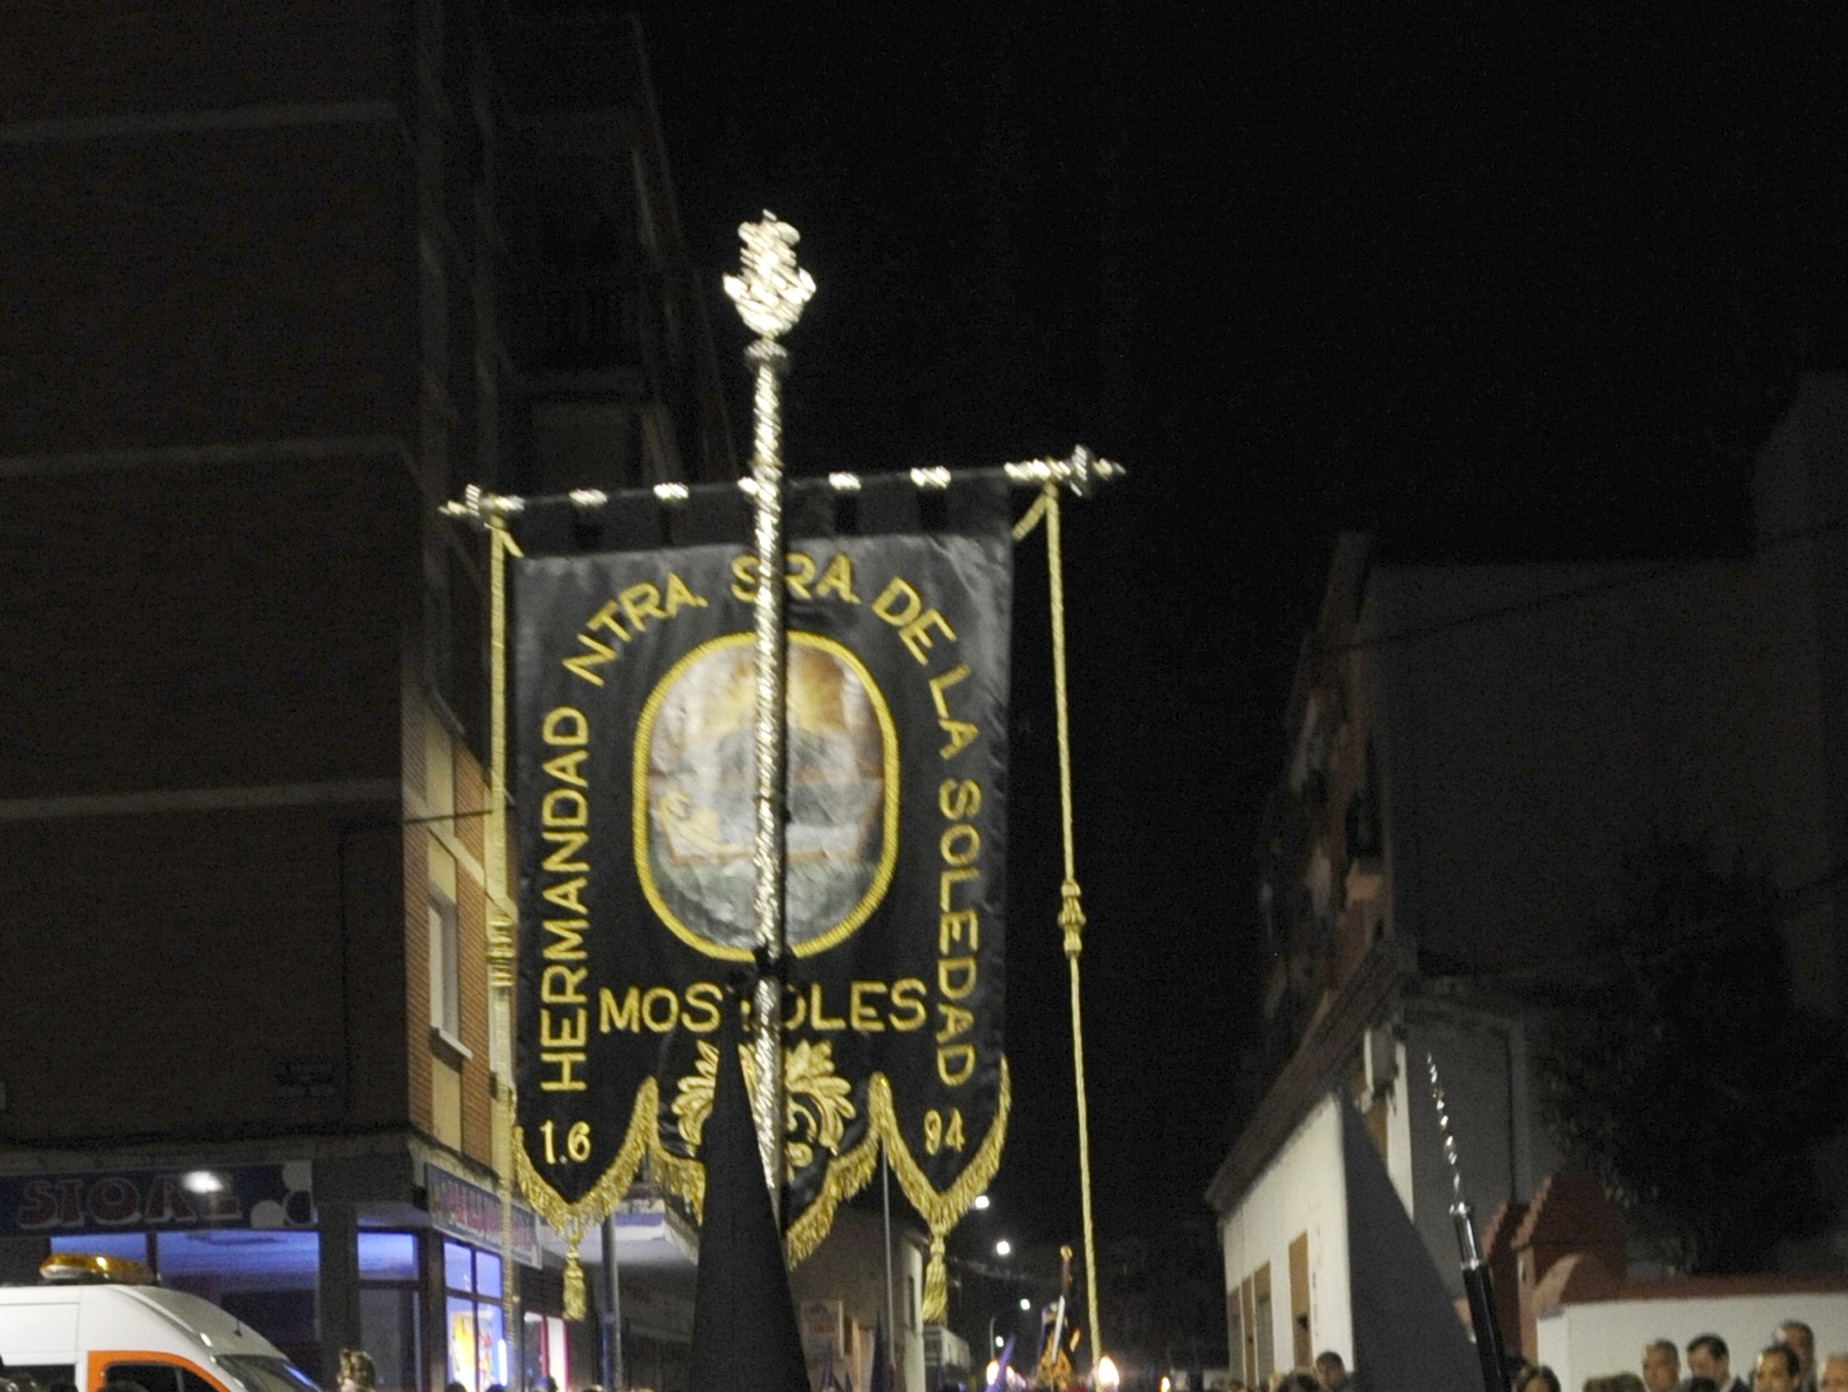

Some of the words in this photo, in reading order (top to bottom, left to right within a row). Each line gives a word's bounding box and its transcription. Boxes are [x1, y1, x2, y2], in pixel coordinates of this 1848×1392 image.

[869, 575, 958, 666] DE
[929, 662, 980, 760] LA
[539, 704, 591, 1093] HERMANDAD
[935, 777, 984, 1088] SOLEDAD
